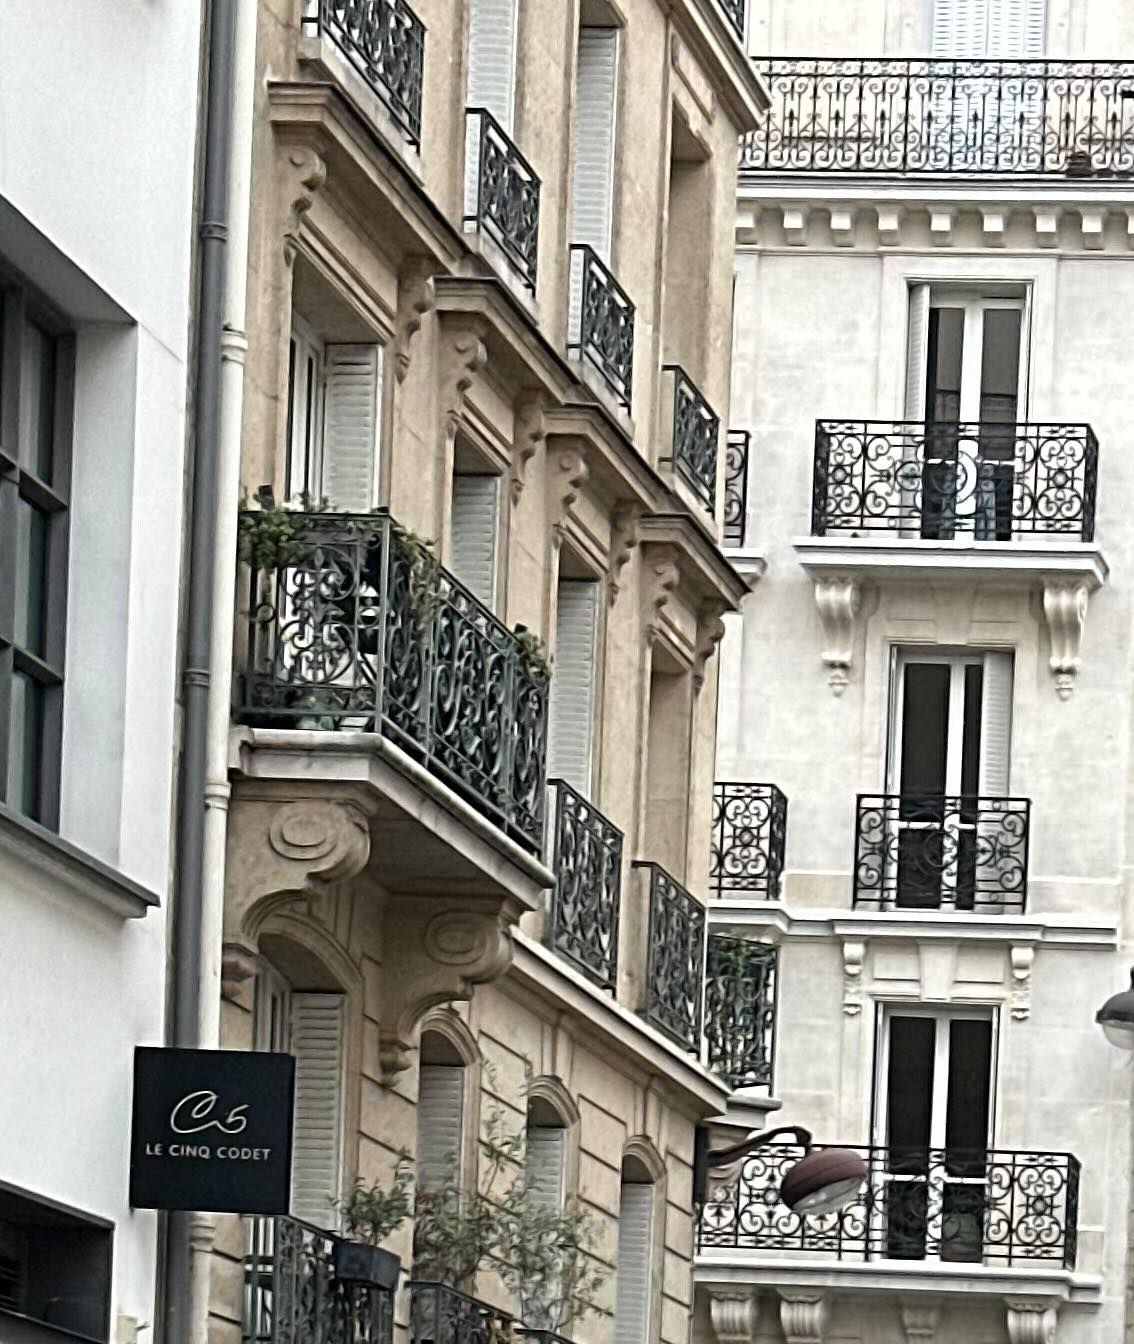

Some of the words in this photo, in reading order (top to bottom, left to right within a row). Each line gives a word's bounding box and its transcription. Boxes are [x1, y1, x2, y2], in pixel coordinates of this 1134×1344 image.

[145, 1142, 164, 1156] LE
[169, 1144, 210, 1159] CINQ
[216, 1146, 271, 1161] CODET
